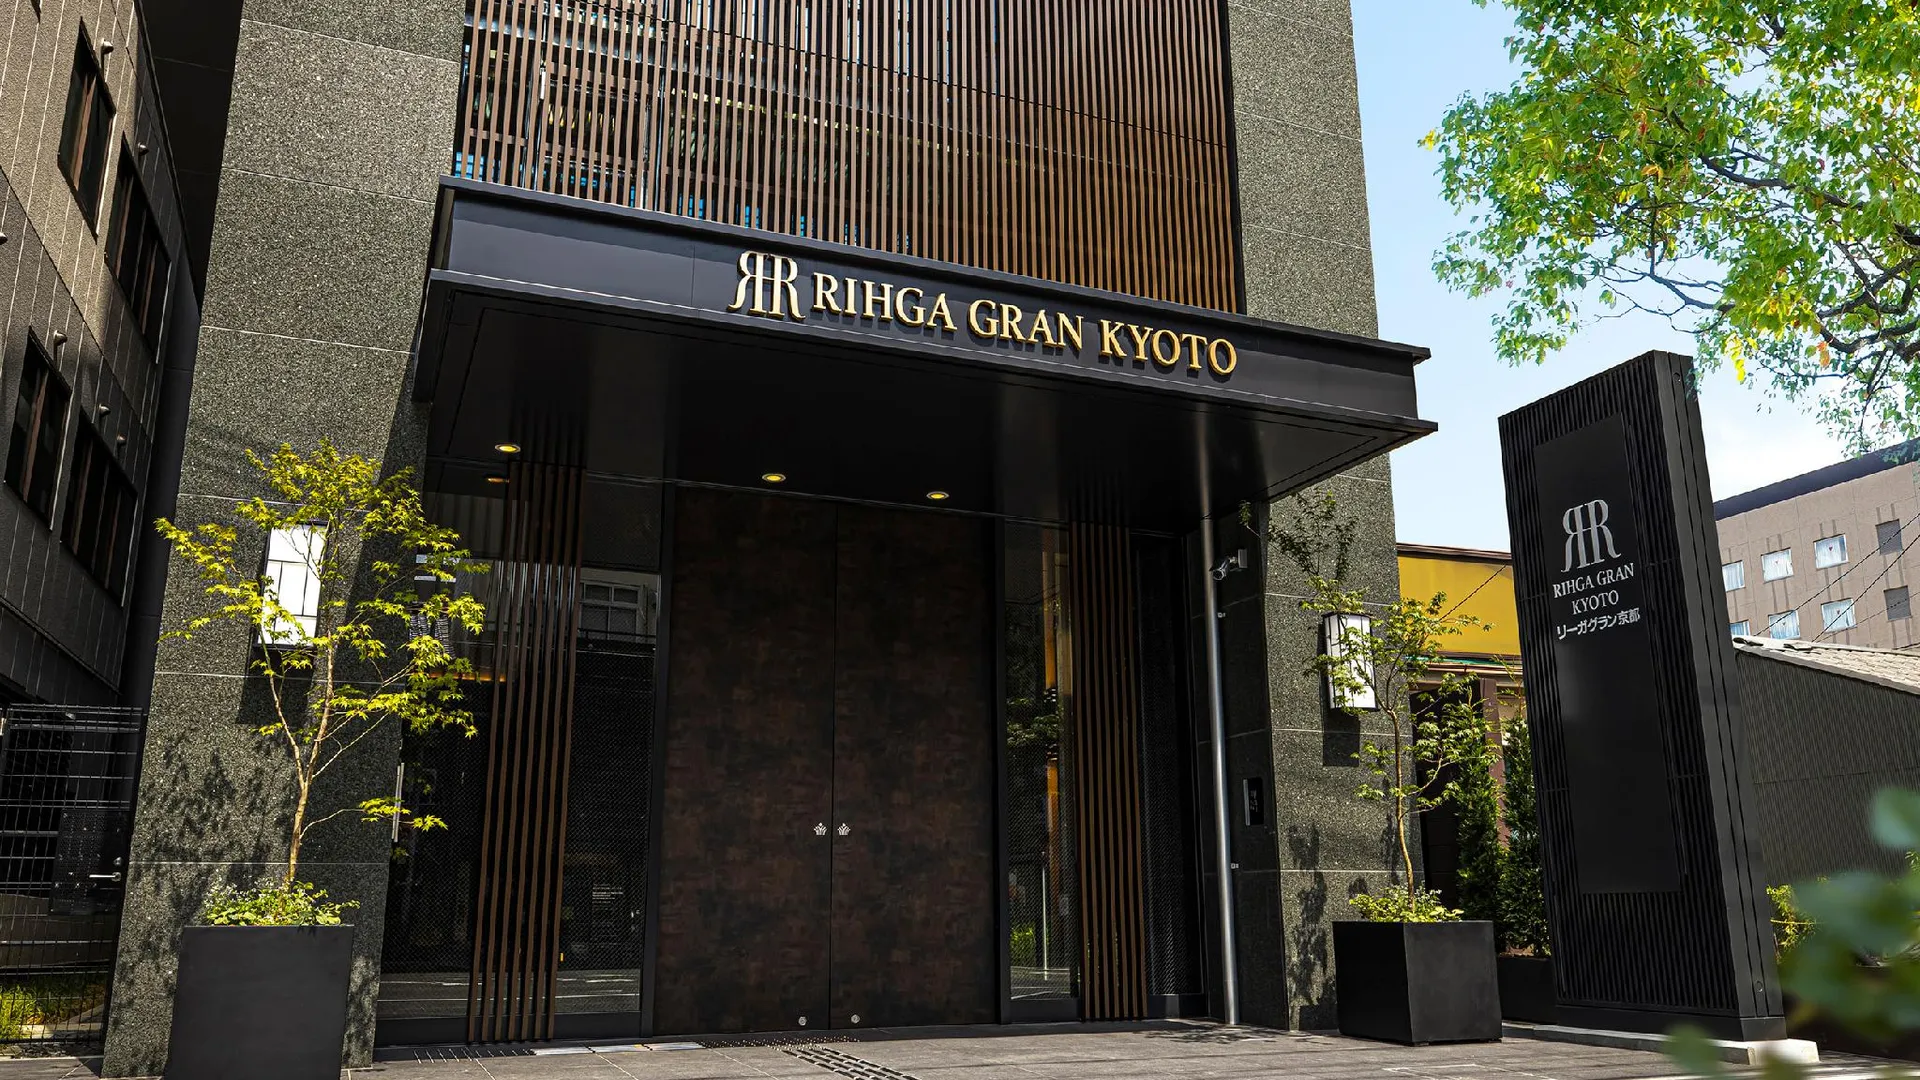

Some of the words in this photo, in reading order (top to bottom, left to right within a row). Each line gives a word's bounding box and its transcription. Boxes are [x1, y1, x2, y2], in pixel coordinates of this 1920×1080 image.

[812, 271, 957, 331] RIHGA
[967, 299, 1084, 351] GRAN
[1099, 320, 1238, 376] KYOTO
[1552, 575, 1595, 598] RIHGA
[1596, 562, 1634, 586] GRAN
[1571, 589, 1619, 615] KYOTO
[1556, 607, 1641, 640] リーガグラン京都
